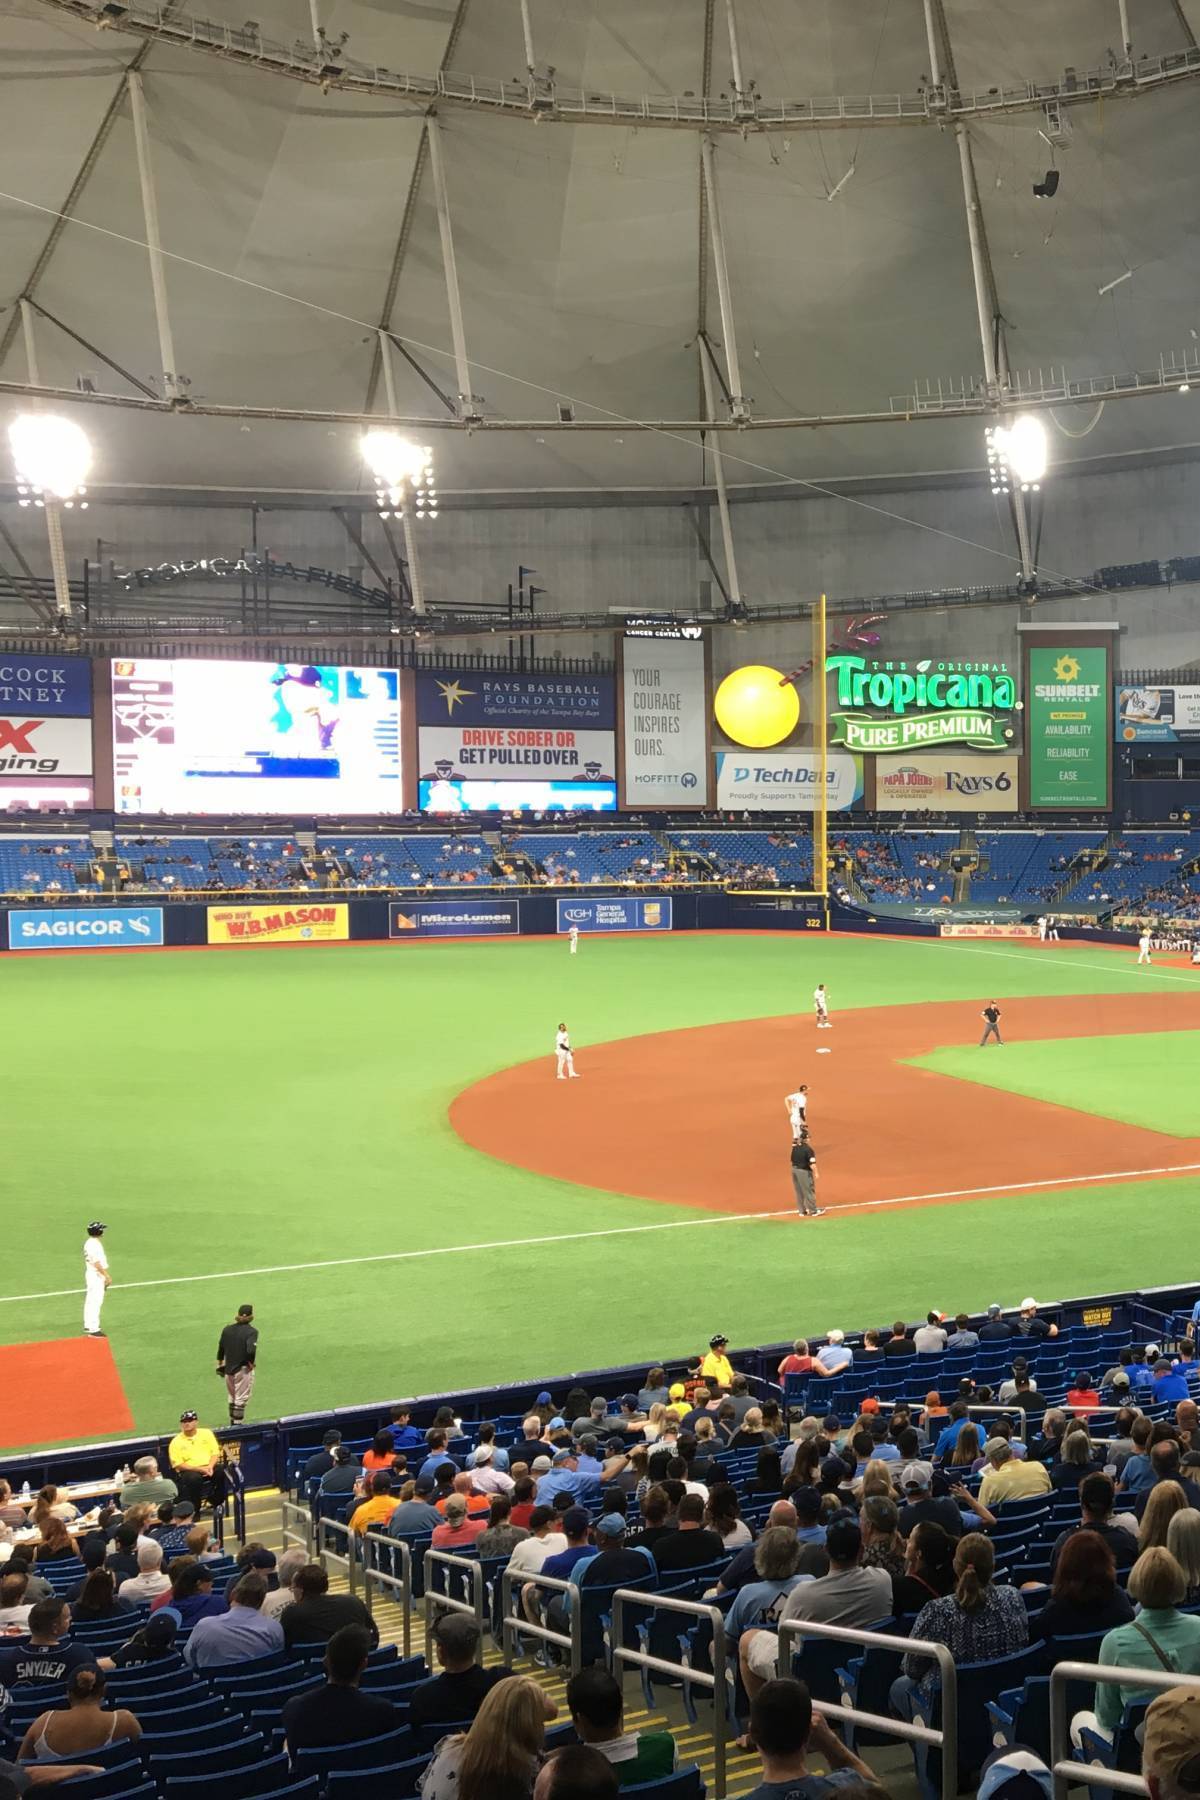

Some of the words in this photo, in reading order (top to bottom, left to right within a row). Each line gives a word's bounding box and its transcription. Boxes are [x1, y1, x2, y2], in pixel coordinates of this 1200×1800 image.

[872, 661, 907, 670] THE
[938, 662, 1008, 672] ORIGINAL
[632, 668, 661, 687] YOUR
[825, 655, 1016, 714] Tropicana
[483, 682, 520, 692] RAYS
[528, 683, 599, 695] BASEBALL
[1035, 685, 1100, 697] SUNBELT
[484, 694, 599, 706] FOUNDATION
[633, 692, 681, 710] COURAGE
[633, 715, 680, 733] INSPIRES
[846, 724, 898, 746] PURE
[902, 717, 993, 742] PREMIUM
[1045, 725, 1092, 735] AVAILABILITY
[462, 730, 504, 746] DRIVE
[507, 730, 553, 747] SOBER
[556, 731, 575, 747] OR
[634, 739, 665, 756] OURS.
[1047, 748, 1090, 758] RELIABILITY
[459, 748, 489, 764] GET
[490, 748, 541, 765] PULLED
[543, 750, 579, 765] OVER
[635, 774, 679, 783] MOFFITT
[753, 768, 793, 783] Tech
[995, 772, 1011, 791] 6
[1059, 771, 1078, 780] EASE
[729, 792, 758, 800] Proudly
[760, 792, 795, 800] Supports
[569, 909, 592, 918] TGH
[22, 919, 124, 937] SAGICOR
[806, 918, 820, 928] 322
[16, 1660, 66, 1679] SNYDER
